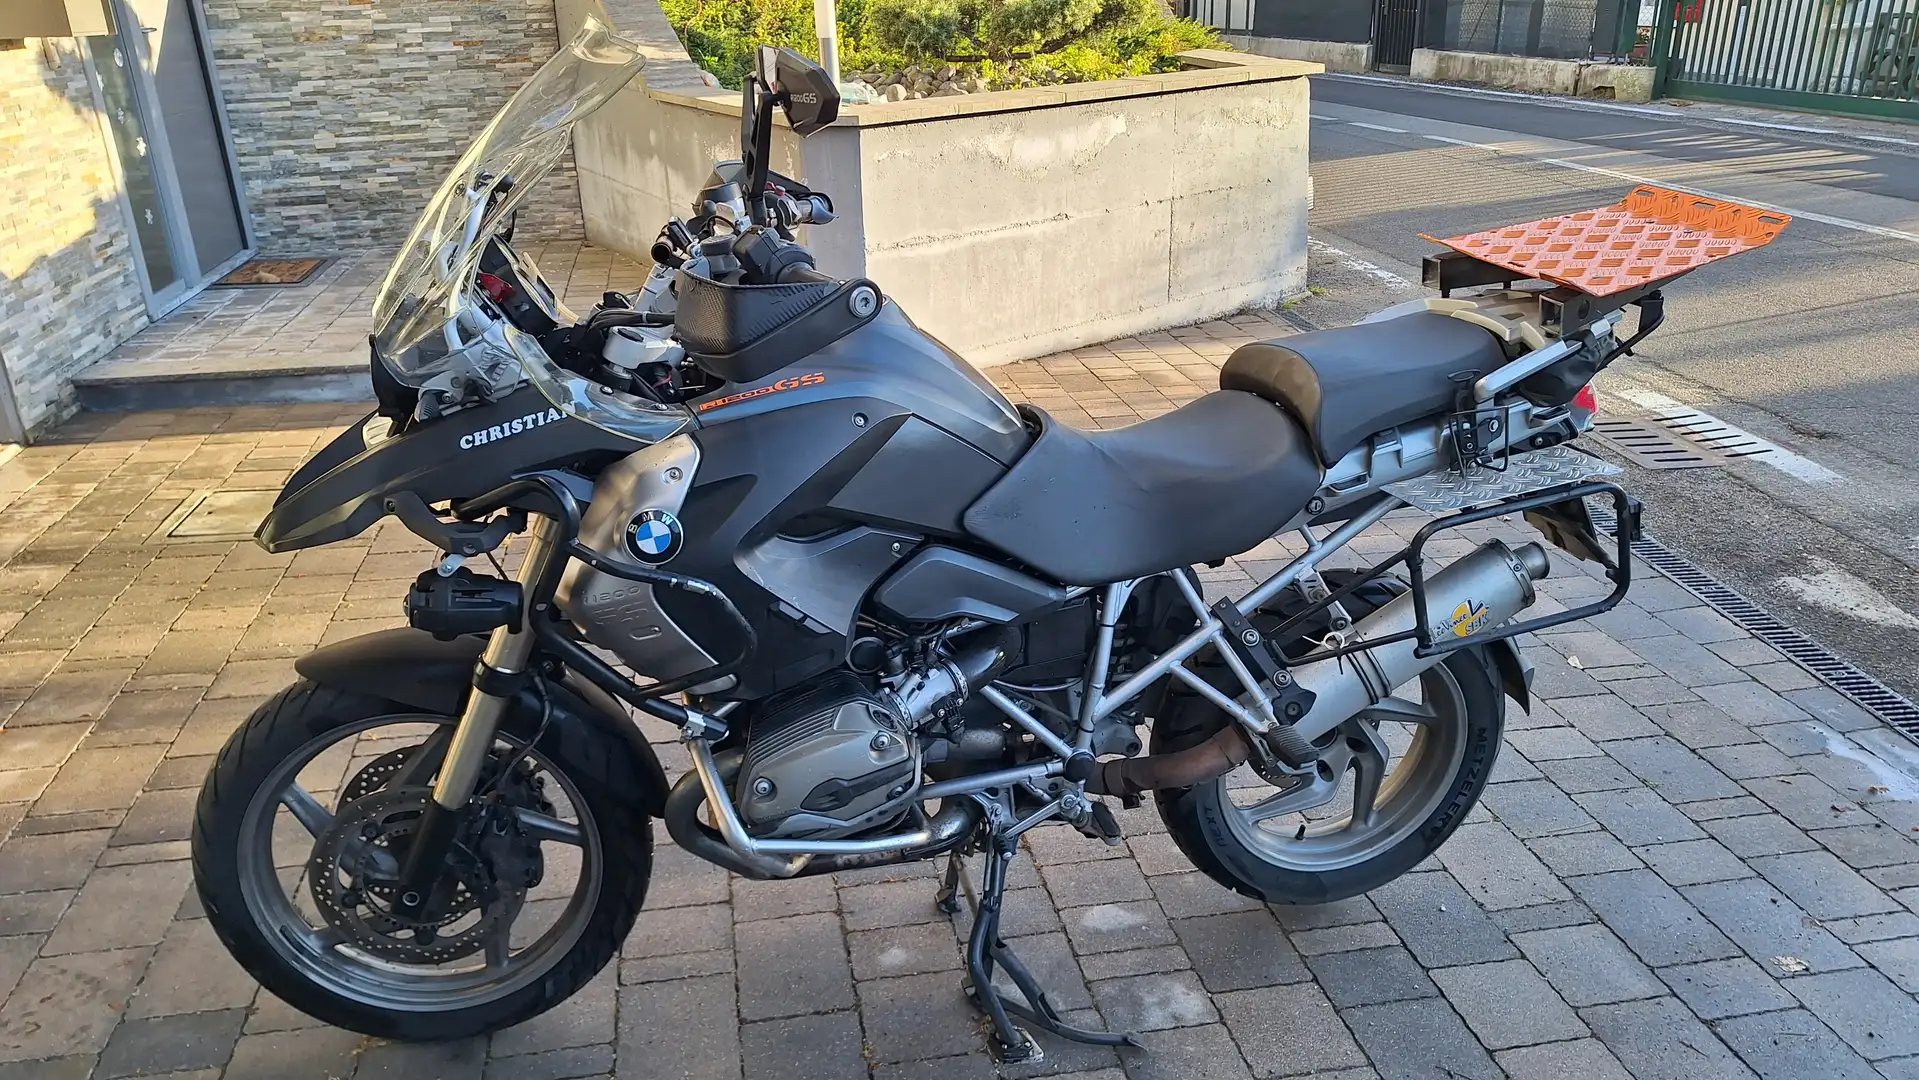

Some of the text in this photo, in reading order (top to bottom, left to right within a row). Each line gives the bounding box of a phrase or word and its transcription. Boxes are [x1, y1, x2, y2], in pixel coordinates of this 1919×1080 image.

[699, 371, 826, 411] R1200GS
[628, 511, 674, 534] BMW
[1437, 727, 1489, 830] METZELER
